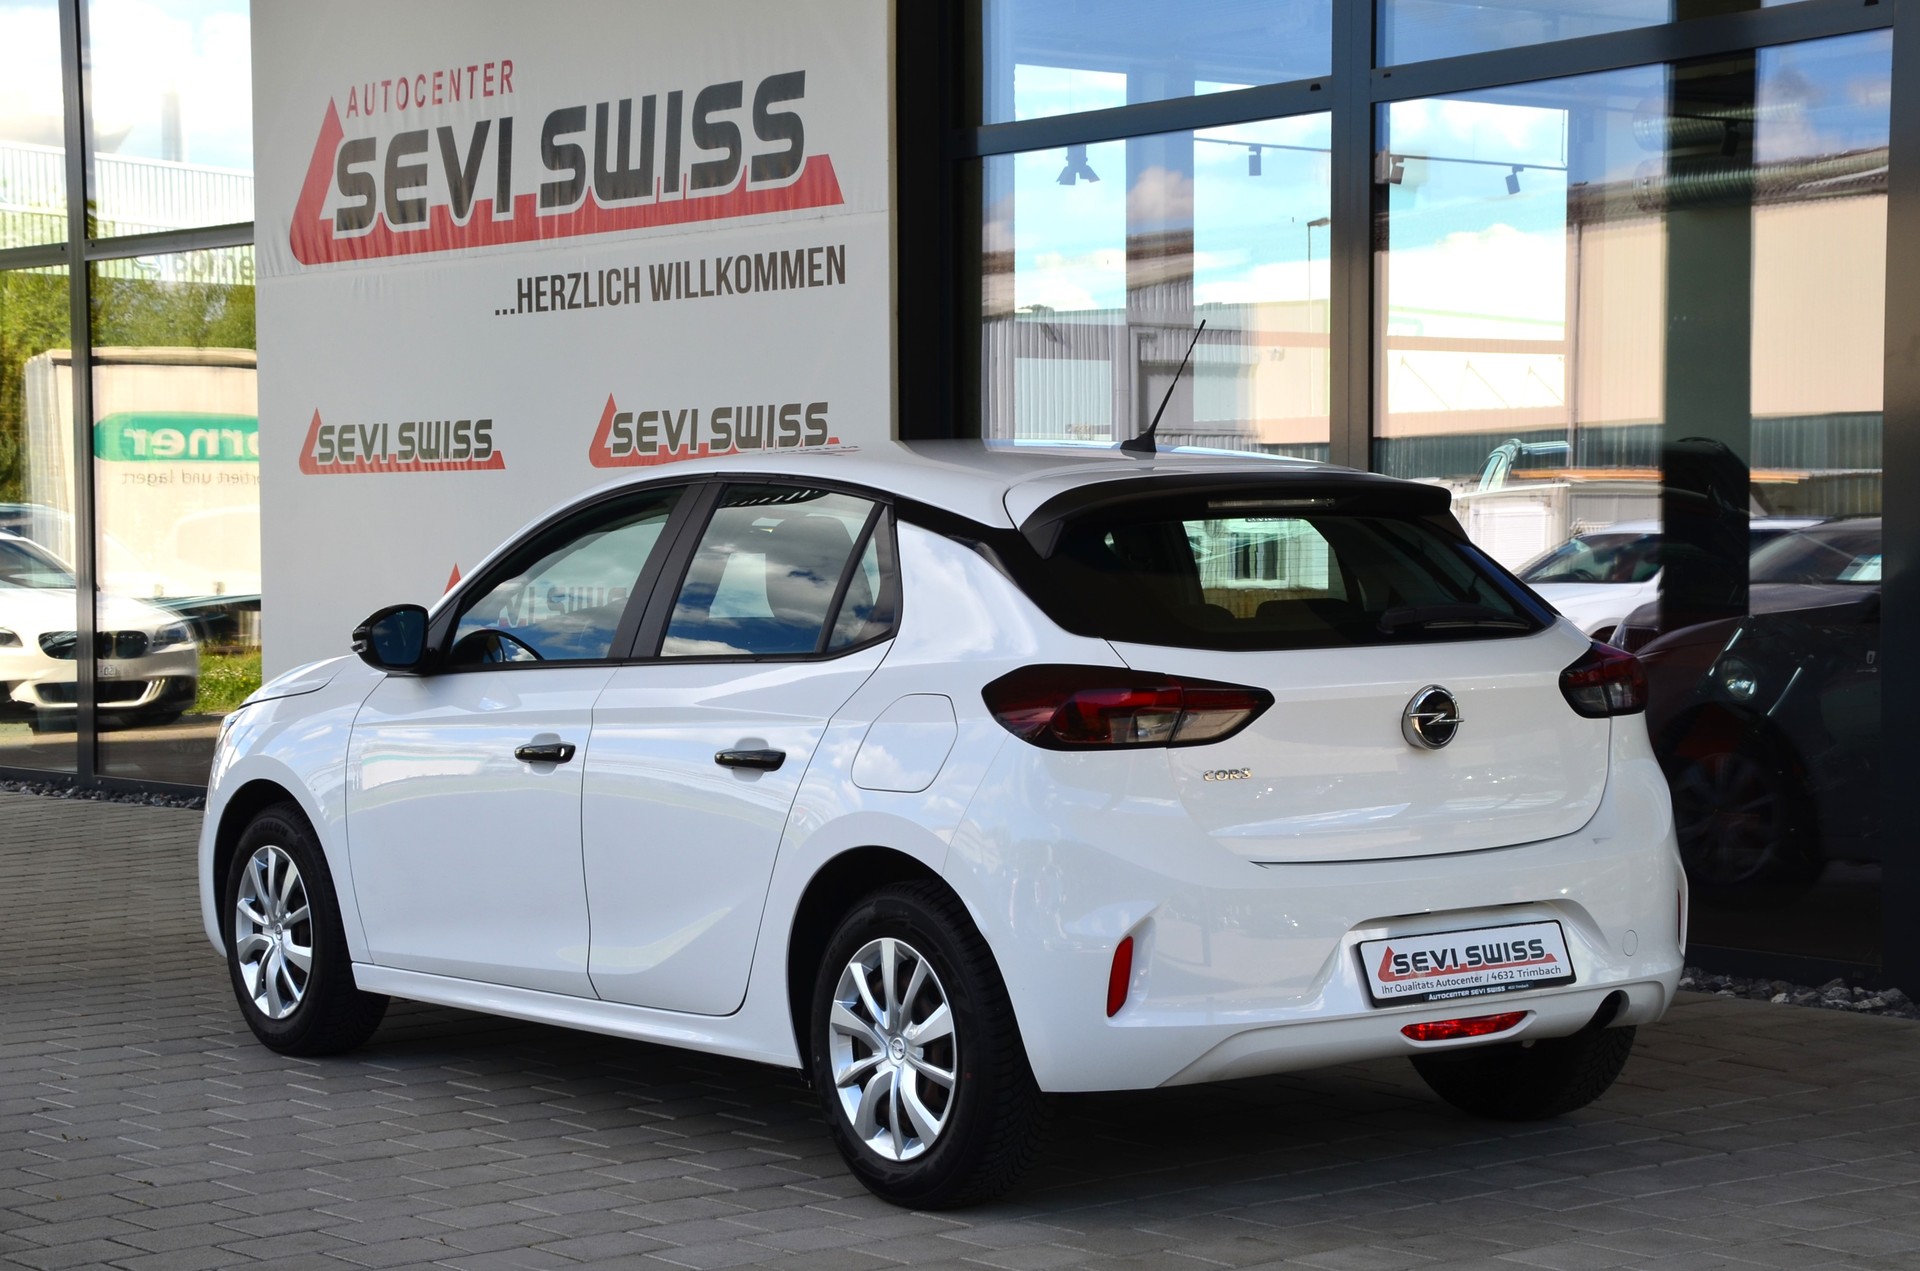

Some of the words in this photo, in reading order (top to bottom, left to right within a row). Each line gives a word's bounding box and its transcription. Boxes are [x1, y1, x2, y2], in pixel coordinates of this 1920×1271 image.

[346, 59, 514, 119] AUTOCENTER
[336, 116, 513, 232] SEVI
[539, 70, 806, 209] SWISS
[494, 267, 640, 316] ...HERZLICH
[649, 244, 846, 302] WILLKOMMEN
[317, 423, 388, 463] SEVI
[398, 419, 493, 461] SWISS
[612, 408, 699, 455] SEVI
[710, 402, 828, 450] SWISS
[1381, 984, 1394, 995] Ihr
[1435, 975, 1483, 987] Autocenter
[1491, 969, 1515, 981] 4632
[1517, 965, 1562, 979] Trimbach
[1393, 948, 1459, 975] SEVI
[1465, 938, 1545, 966] SWISS
